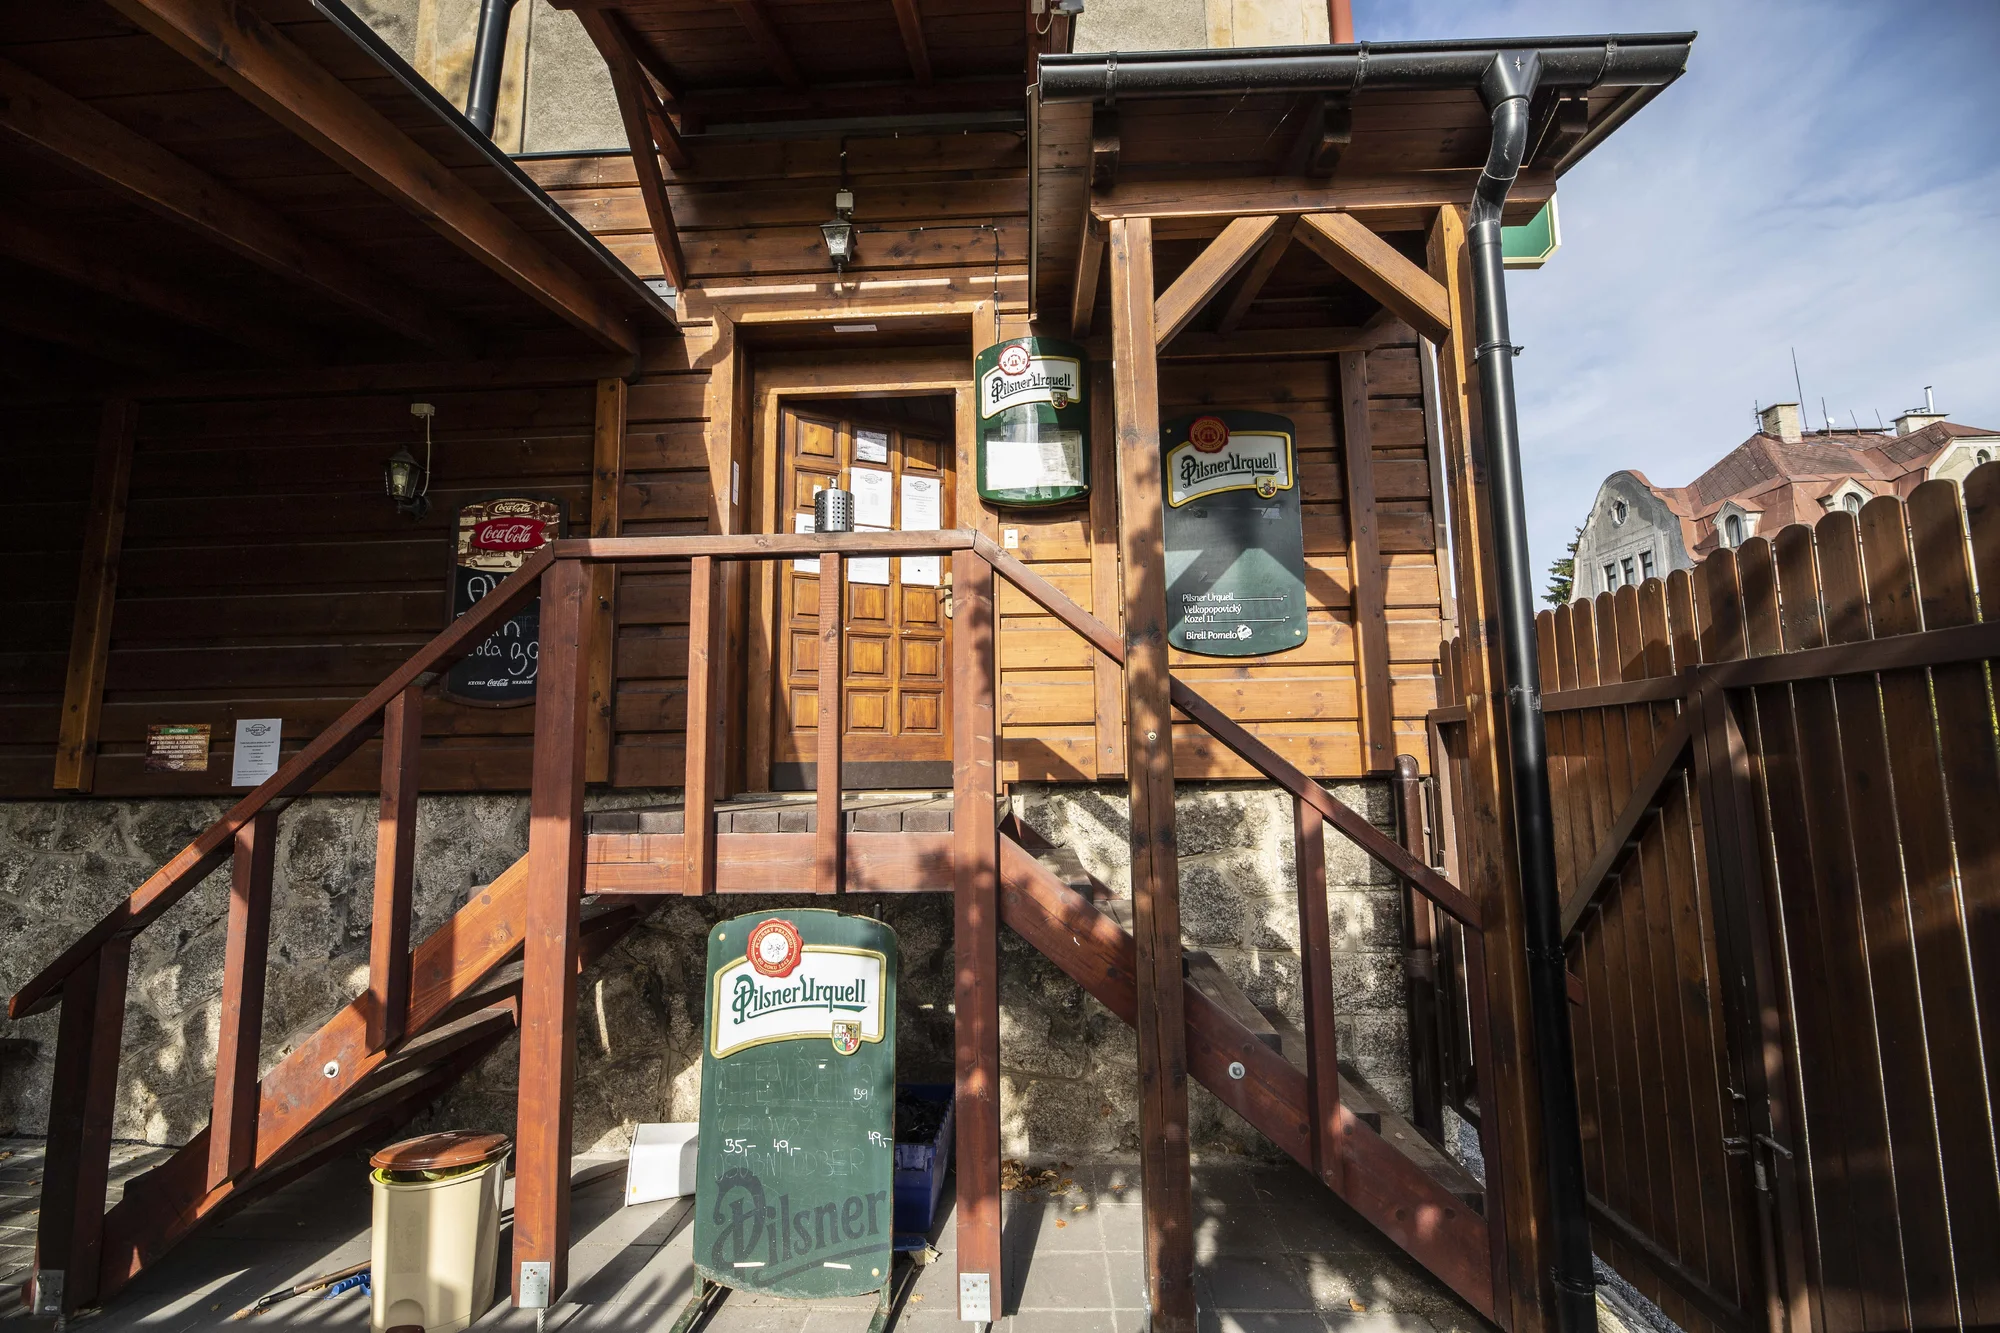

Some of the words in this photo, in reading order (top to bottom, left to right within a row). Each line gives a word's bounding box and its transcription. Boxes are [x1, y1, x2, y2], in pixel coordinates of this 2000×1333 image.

[991, 376, 1032, 404] Pilsner
[1030, 371, 1071, 391] Urquell
[1180, 455, 1230, 488] Pilsner
[1228, 452, 1277, 476] Urquell
[494, 503, 532, 513] Coca-Cola
[480, 524, 534, 543] Coca-Cola
[1182, 593, 1205, 603] Pilsner
[1207, 592, 1234, 603] Urquell
[1183, 603, 1242, 615] Velkopopovický
[1184, 614, 1206, 623] Kozel
[1207, 614, 1215, 623] 11
[1186, 630, 1207, 640] Birell
[1208, 630, 1238, 640] Pomelo
[731, 974, 802, 1025] Pilsner
[799, 973, 866, 1014] Urquell
[852, 1087, 869, 1101] 39
[710, 1166, 888, 1283] Pilsner
